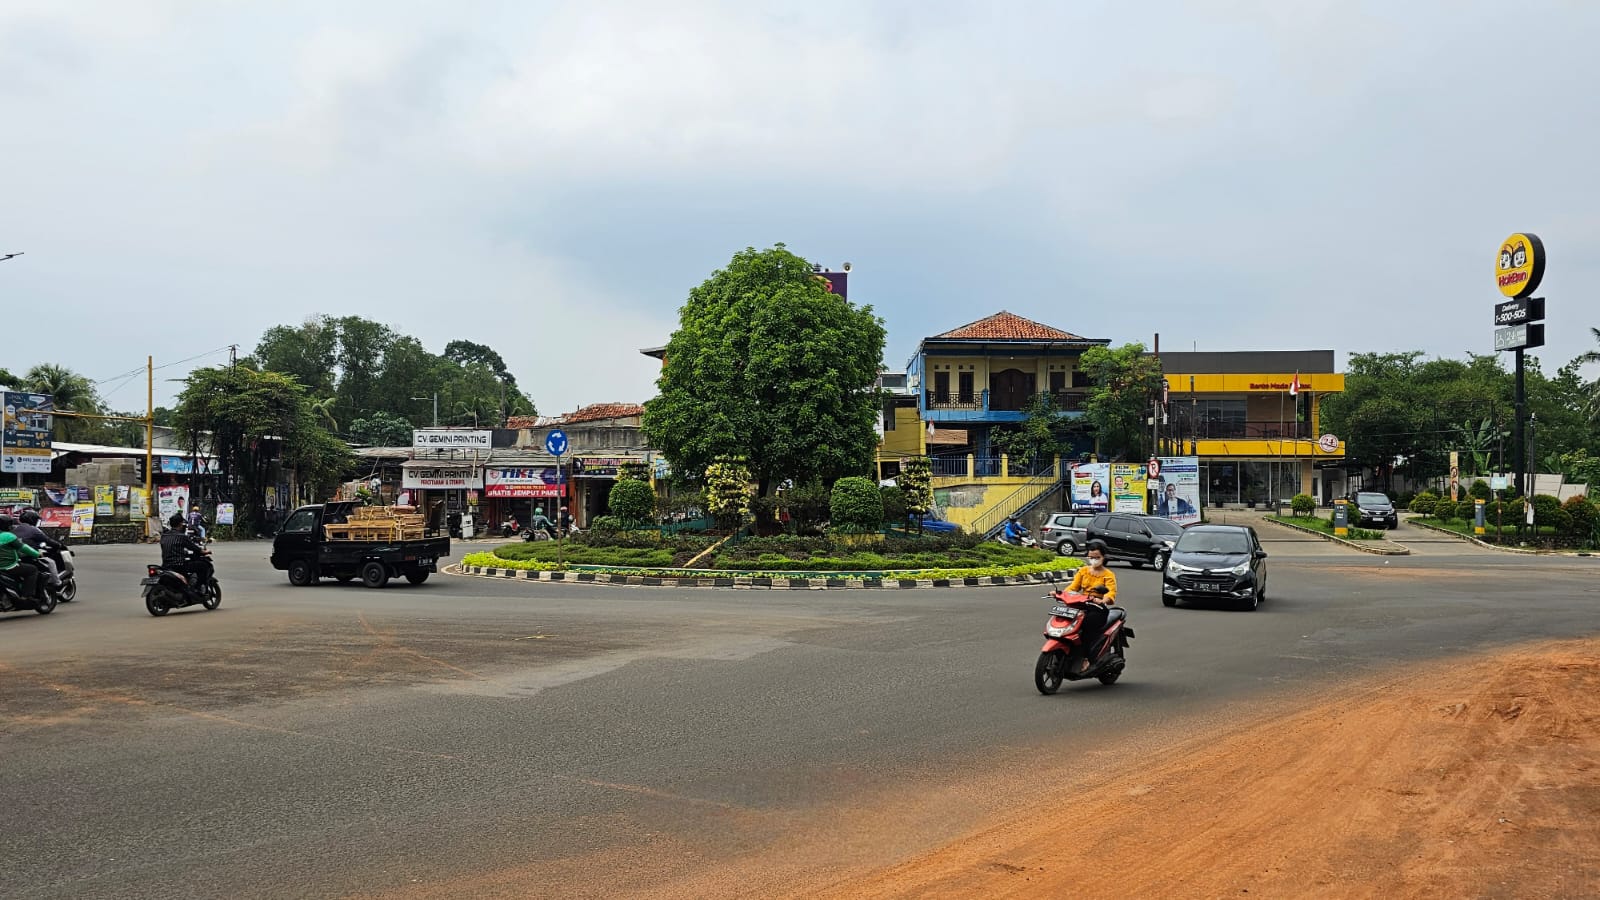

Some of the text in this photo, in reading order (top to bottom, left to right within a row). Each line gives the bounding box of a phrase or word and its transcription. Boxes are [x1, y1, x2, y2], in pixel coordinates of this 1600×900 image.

[1502, 303, 1519, 312] Delivery
[429, 435, 453, 443] GEMINI
[453, 435, 487, 444] PRINTING
[420, 471, 444, 479] GEMINI
[444, 471, 478, 479] PRINTING
[501, 468, 534, 478] TIKI
